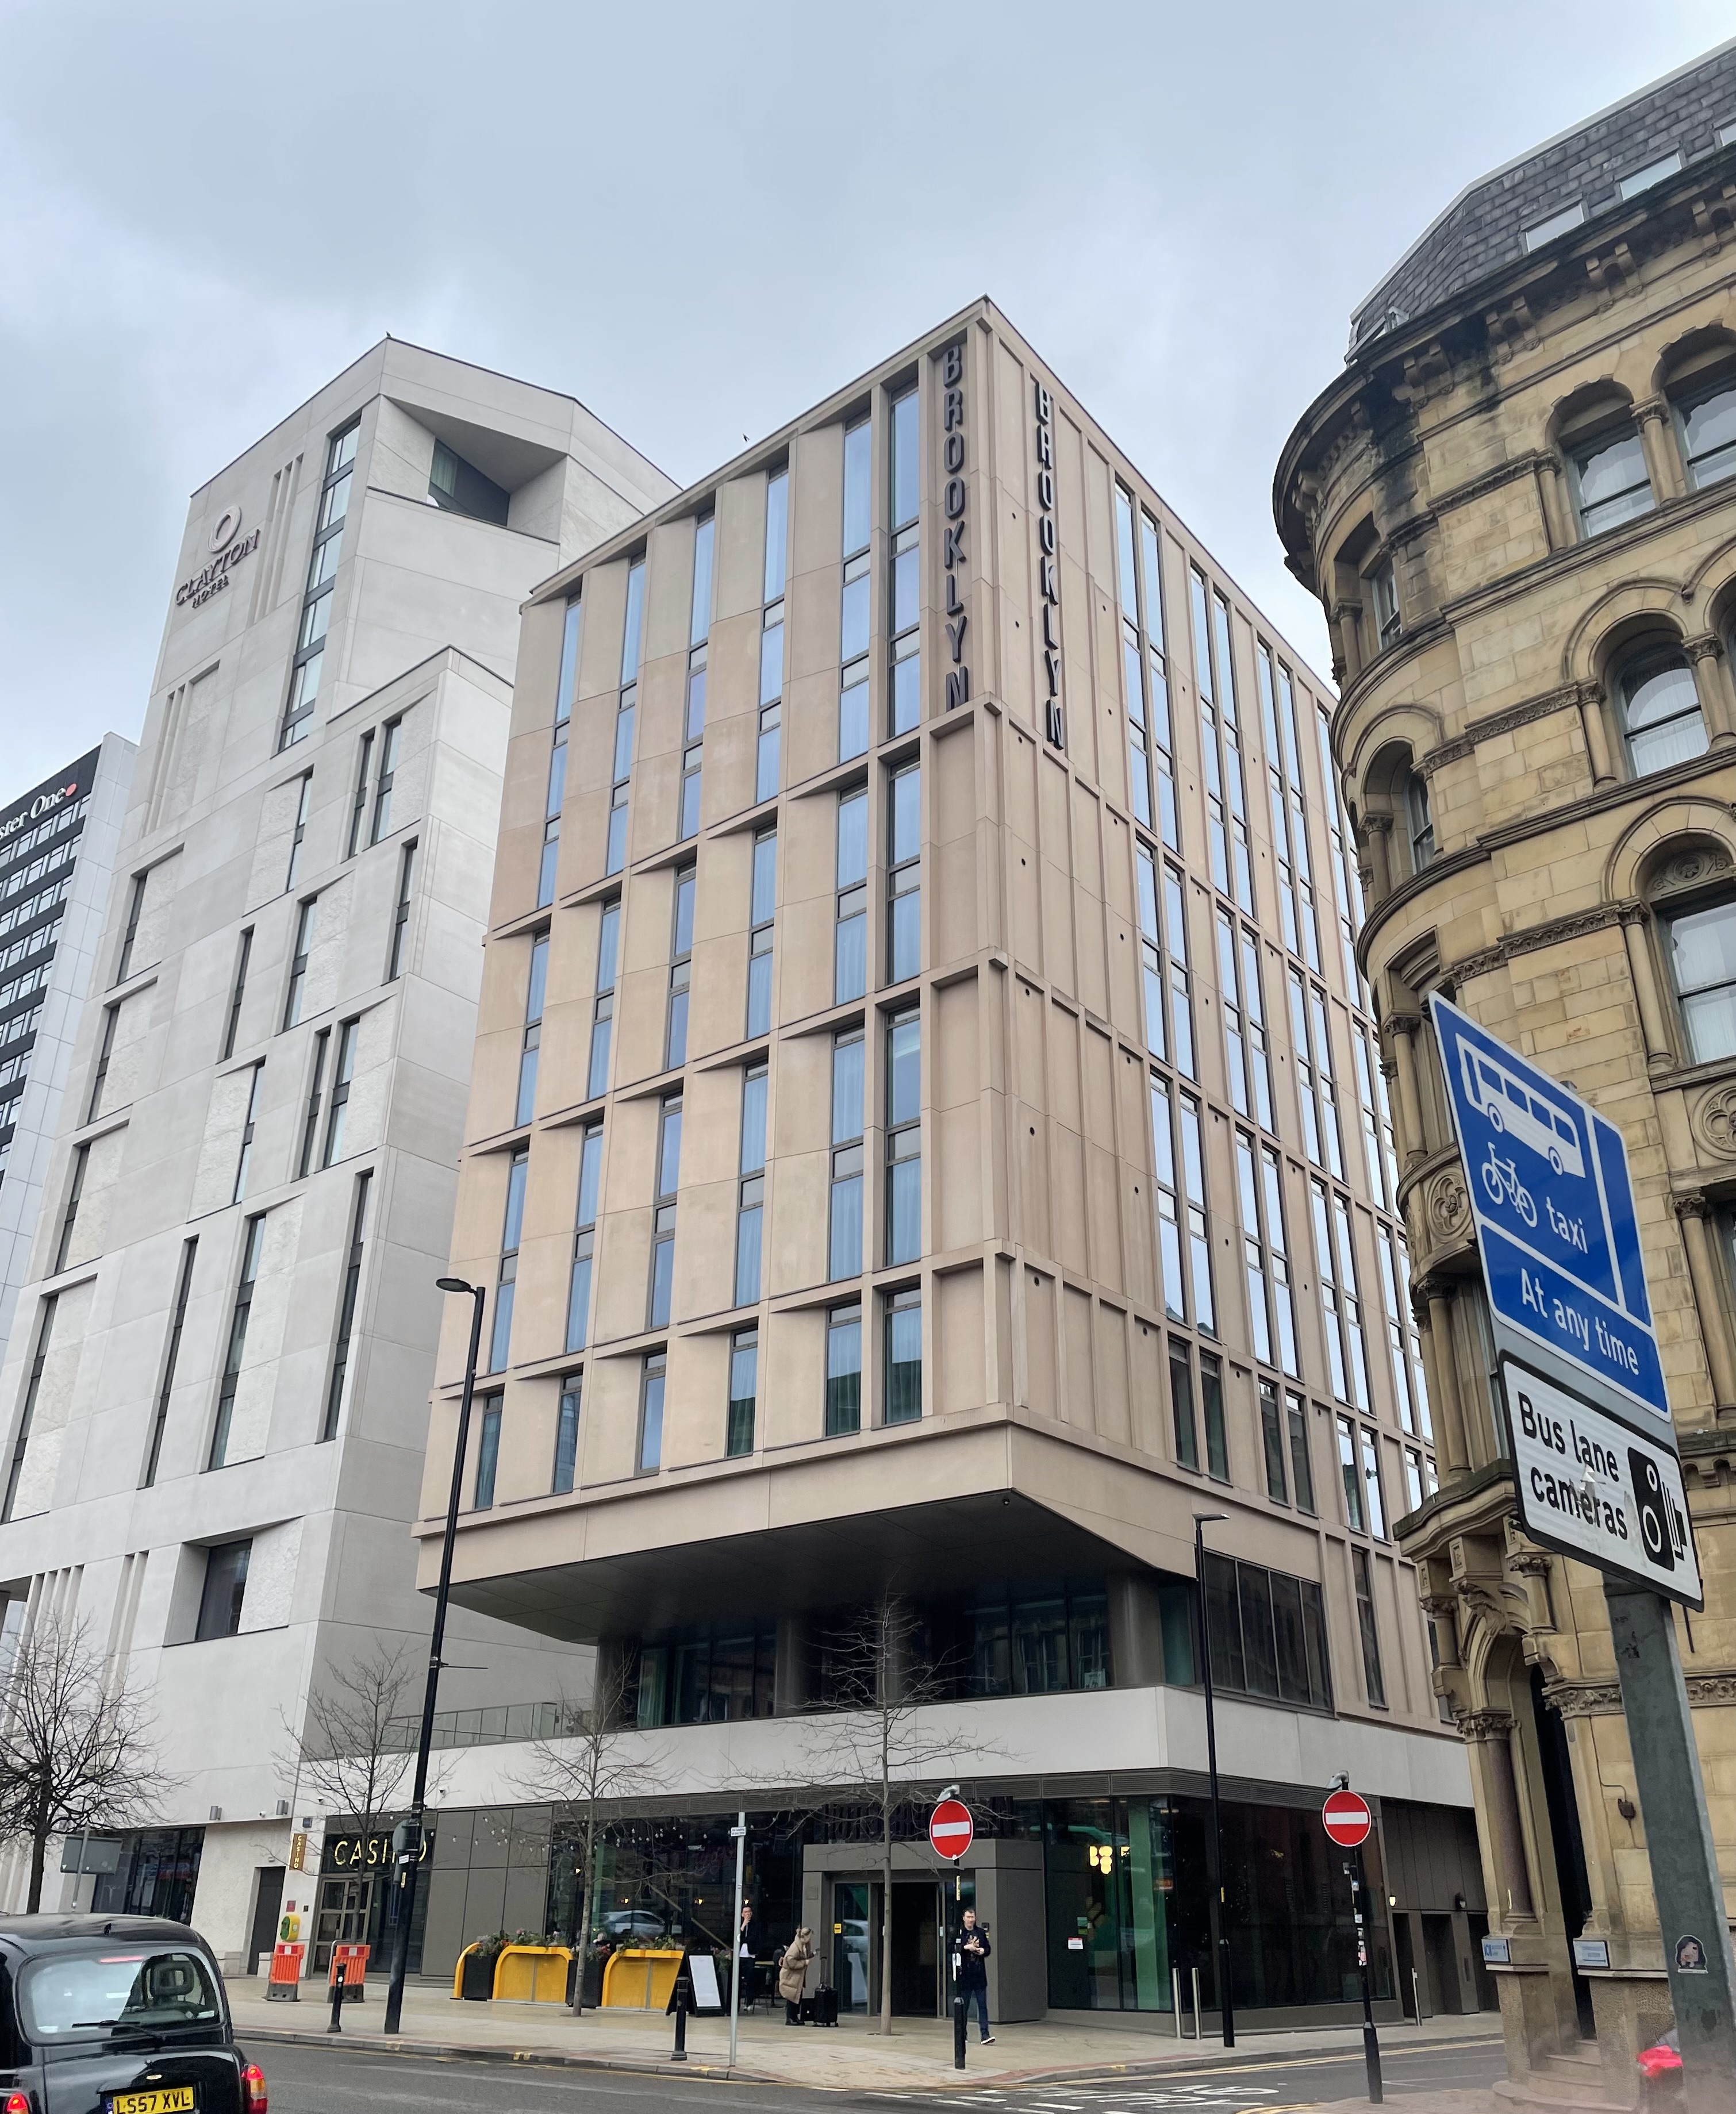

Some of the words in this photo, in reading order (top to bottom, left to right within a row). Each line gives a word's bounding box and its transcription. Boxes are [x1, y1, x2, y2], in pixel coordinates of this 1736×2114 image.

[943, 345, 969, 713] BROOKLYN
[175, 529, 261, 606] CLAYTON
[191, 575, 229, 609] HOTEL
[1035, 381, 1065, 751] BROOKLYN
[30, 787, 66, 819] One
[1546, 1196, 1588, 1254] taxi
[1521, 1268, 1548, 1319] At
[1553, 1298, 1589, 1351] any
[1595, 1317, 1639, 1375] time
[1518, 1390, 1565, 1455] Bus
[1570, 1419, 1619, 1482] lane
[1531, 1467, 1628, 1540] cameras
[294, 1835, 302, 1869] CASINO
[335, 1839, 427, 1865] CASI
[117, 2095, 157, 2114] LS57
[162, 2091, 190, 2110] XVL
